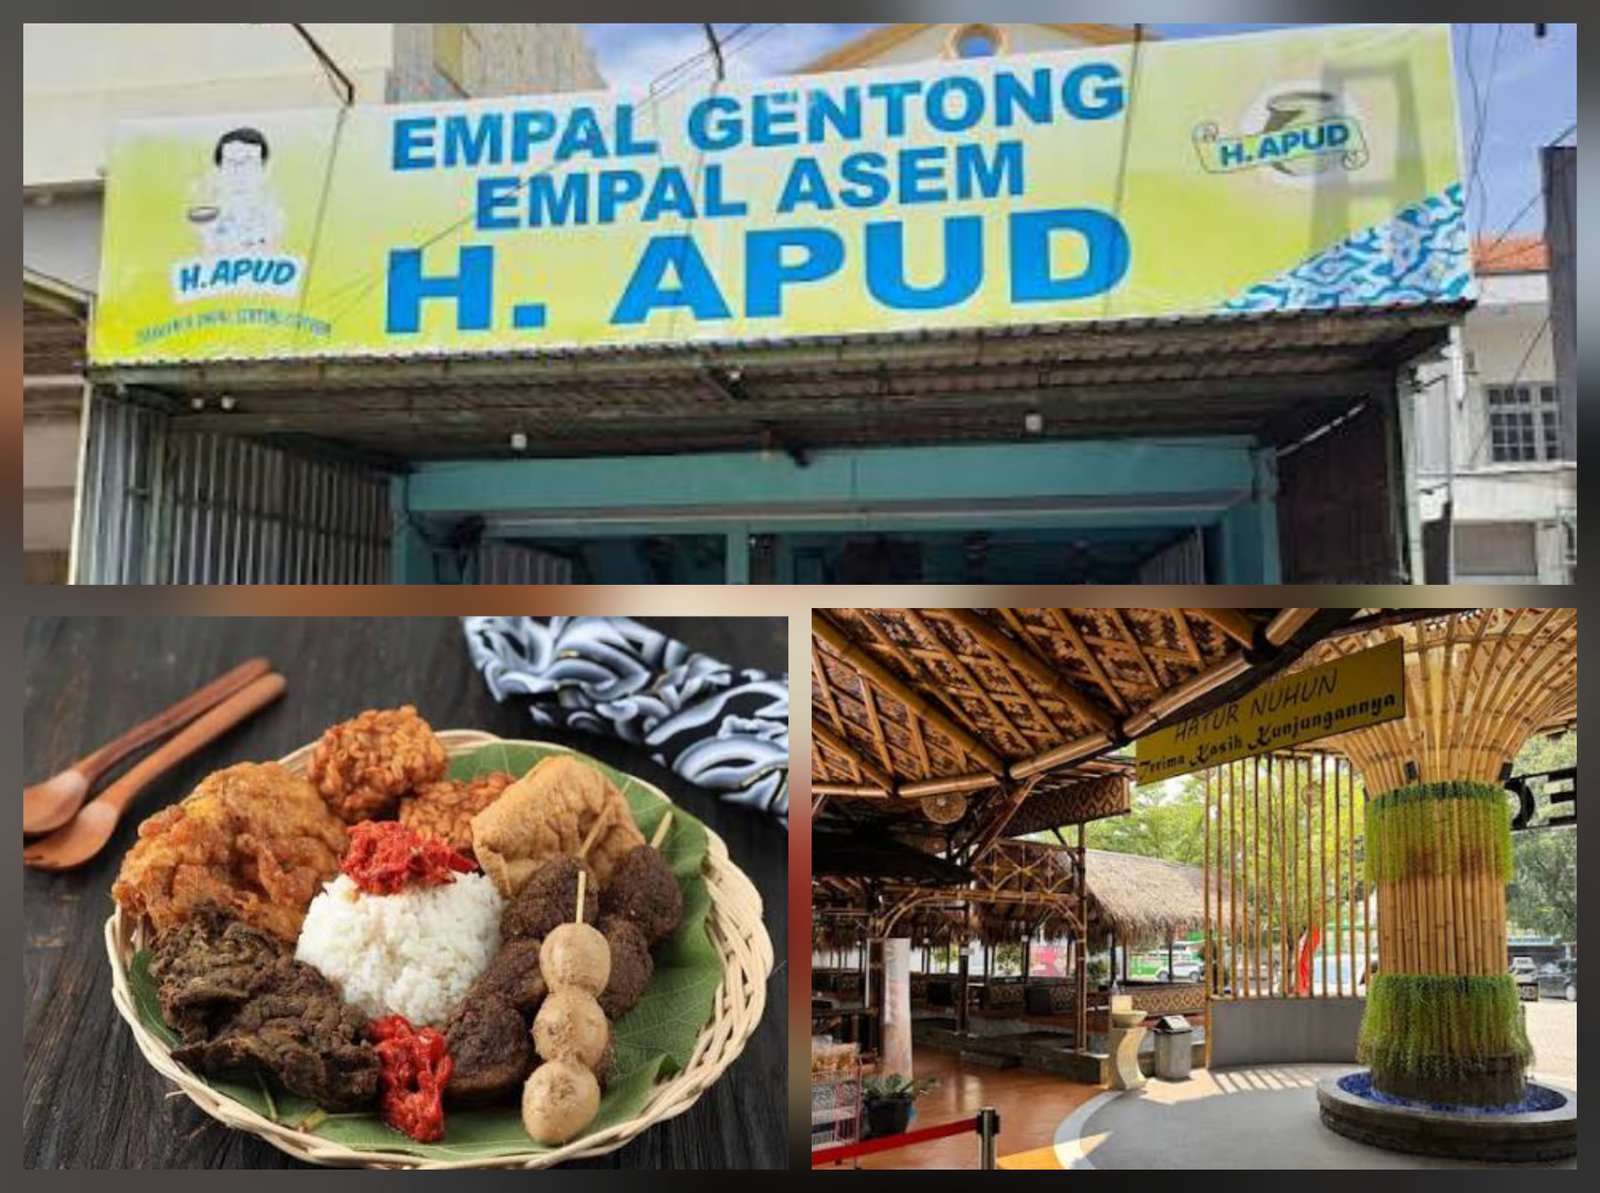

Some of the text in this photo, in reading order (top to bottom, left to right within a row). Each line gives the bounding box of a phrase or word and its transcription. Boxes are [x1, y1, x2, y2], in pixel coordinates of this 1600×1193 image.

[392, 62, 1125, 170] EMPAL GENTONG
[476, 140, 1025, 231] EMPAL ASEM
[385, 208, 1132, 334] H. APUD
[1174, 668, 1338, 744] HATUR NUHUN
[1189, 736, 1243, 767] Kasih
